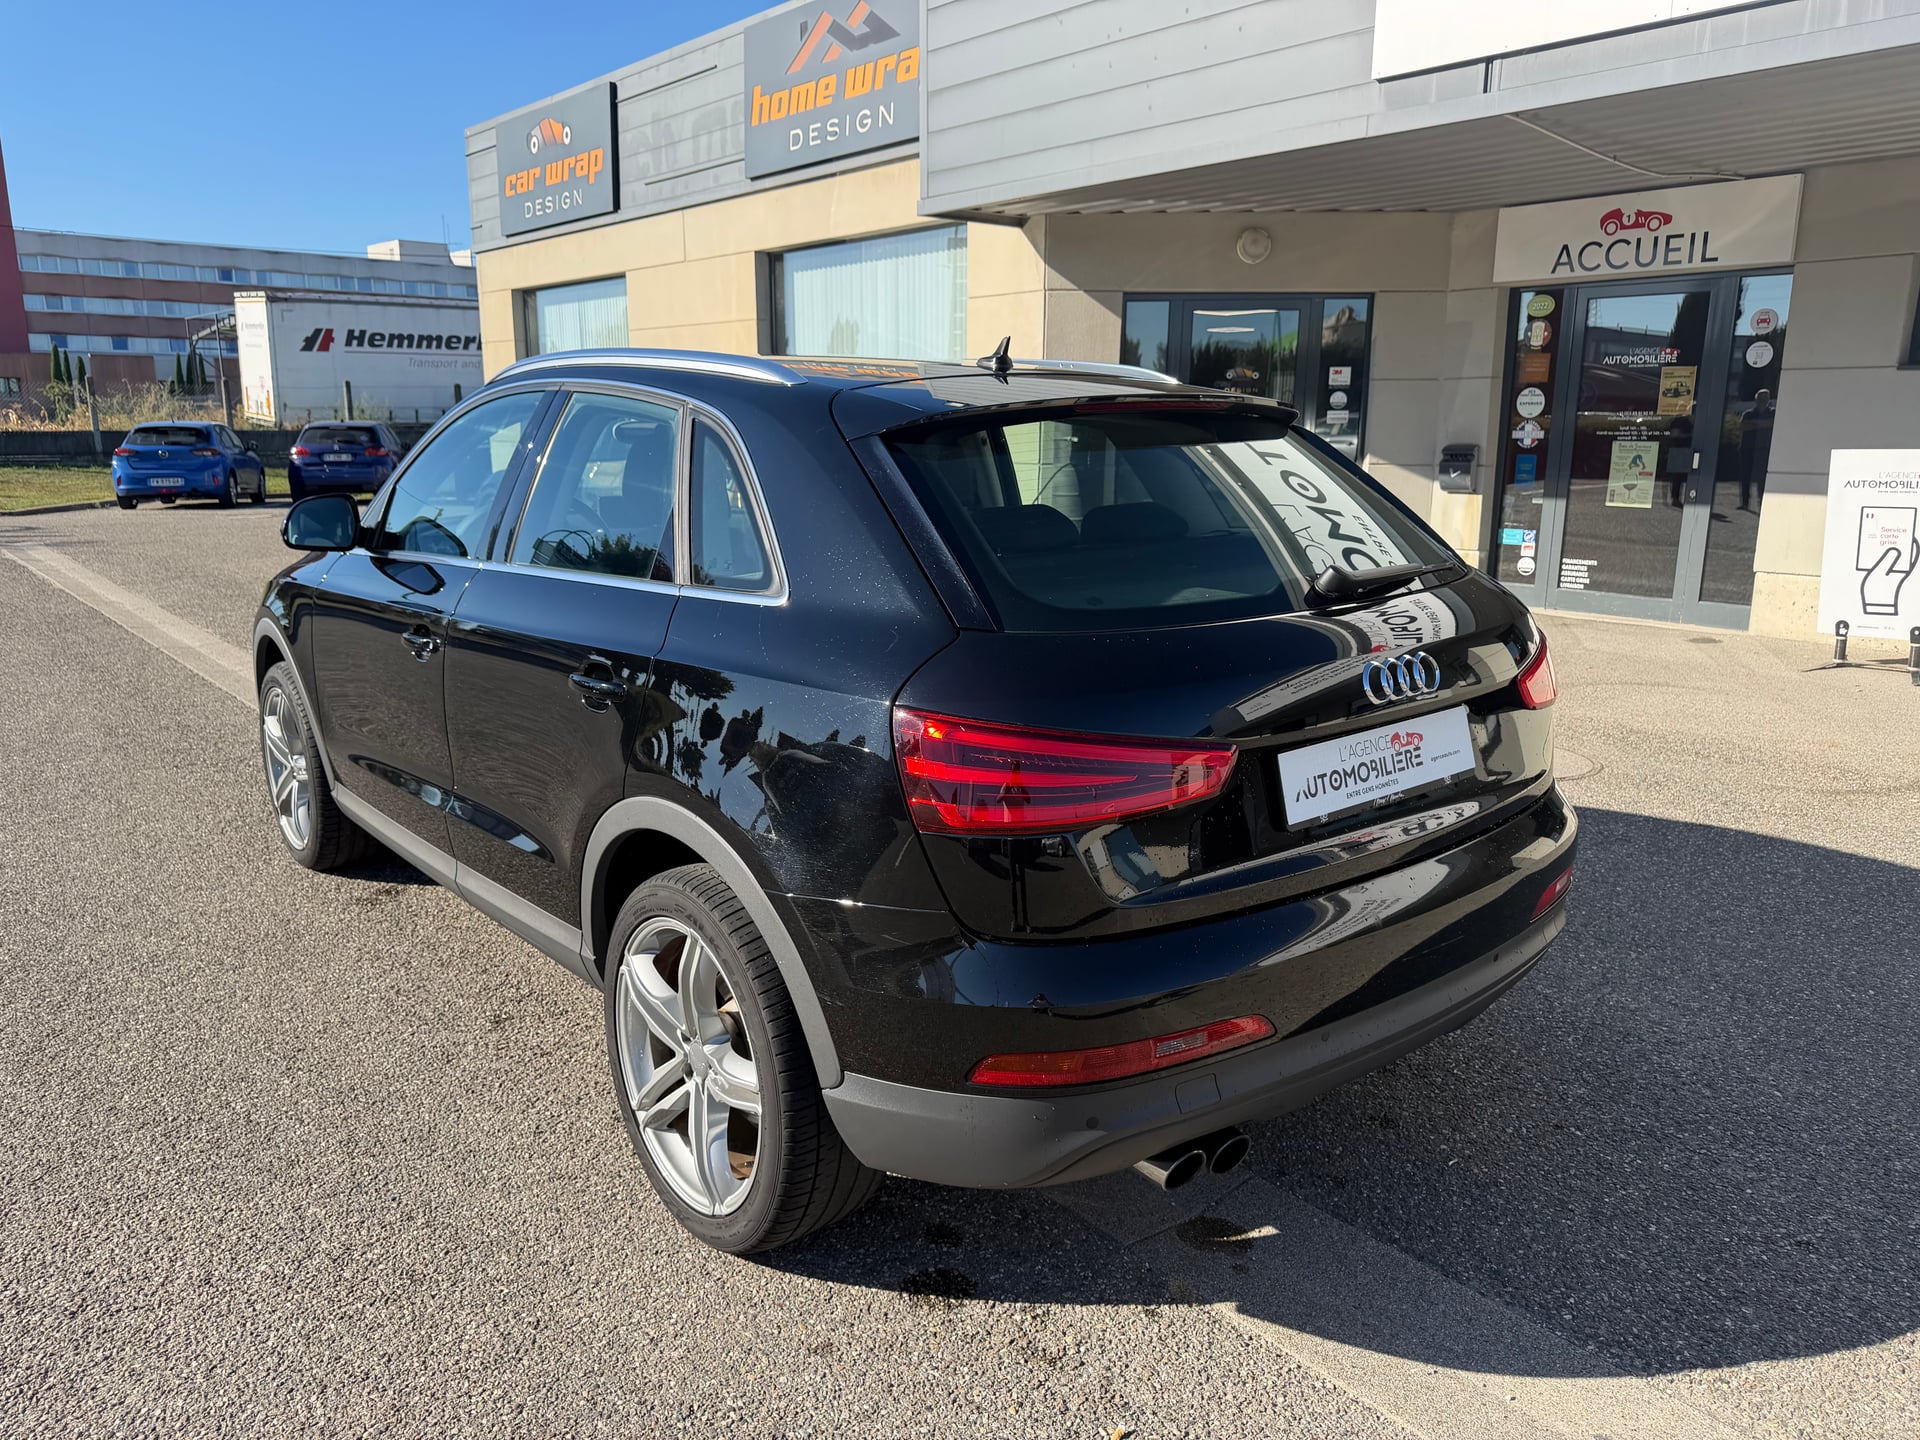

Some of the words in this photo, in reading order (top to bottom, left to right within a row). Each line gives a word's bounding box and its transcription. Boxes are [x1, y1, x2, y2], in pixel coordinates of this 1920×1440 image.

[751, 73, 837, 127] home
[844, 47, 920, 100] wra
[789, 102, 894, 151] DESIGN
[504, 166, 541, 198] car
[545, 147, 604, 186] wrap
[524, 188, 583, 218] DESIGN
[1550, 231, 1719, 274] ACCUEIL
[408, 357, 457, 369] Transport
[461, 359, 480, 369] and
[1878, 471, 1918, 479] L'AGENCE
[1338, 733, 1392, 762] L'AGENCE
[1346, 788, 1361, 799] ENTRE
[1362, 785, 1375, 796] GENS
